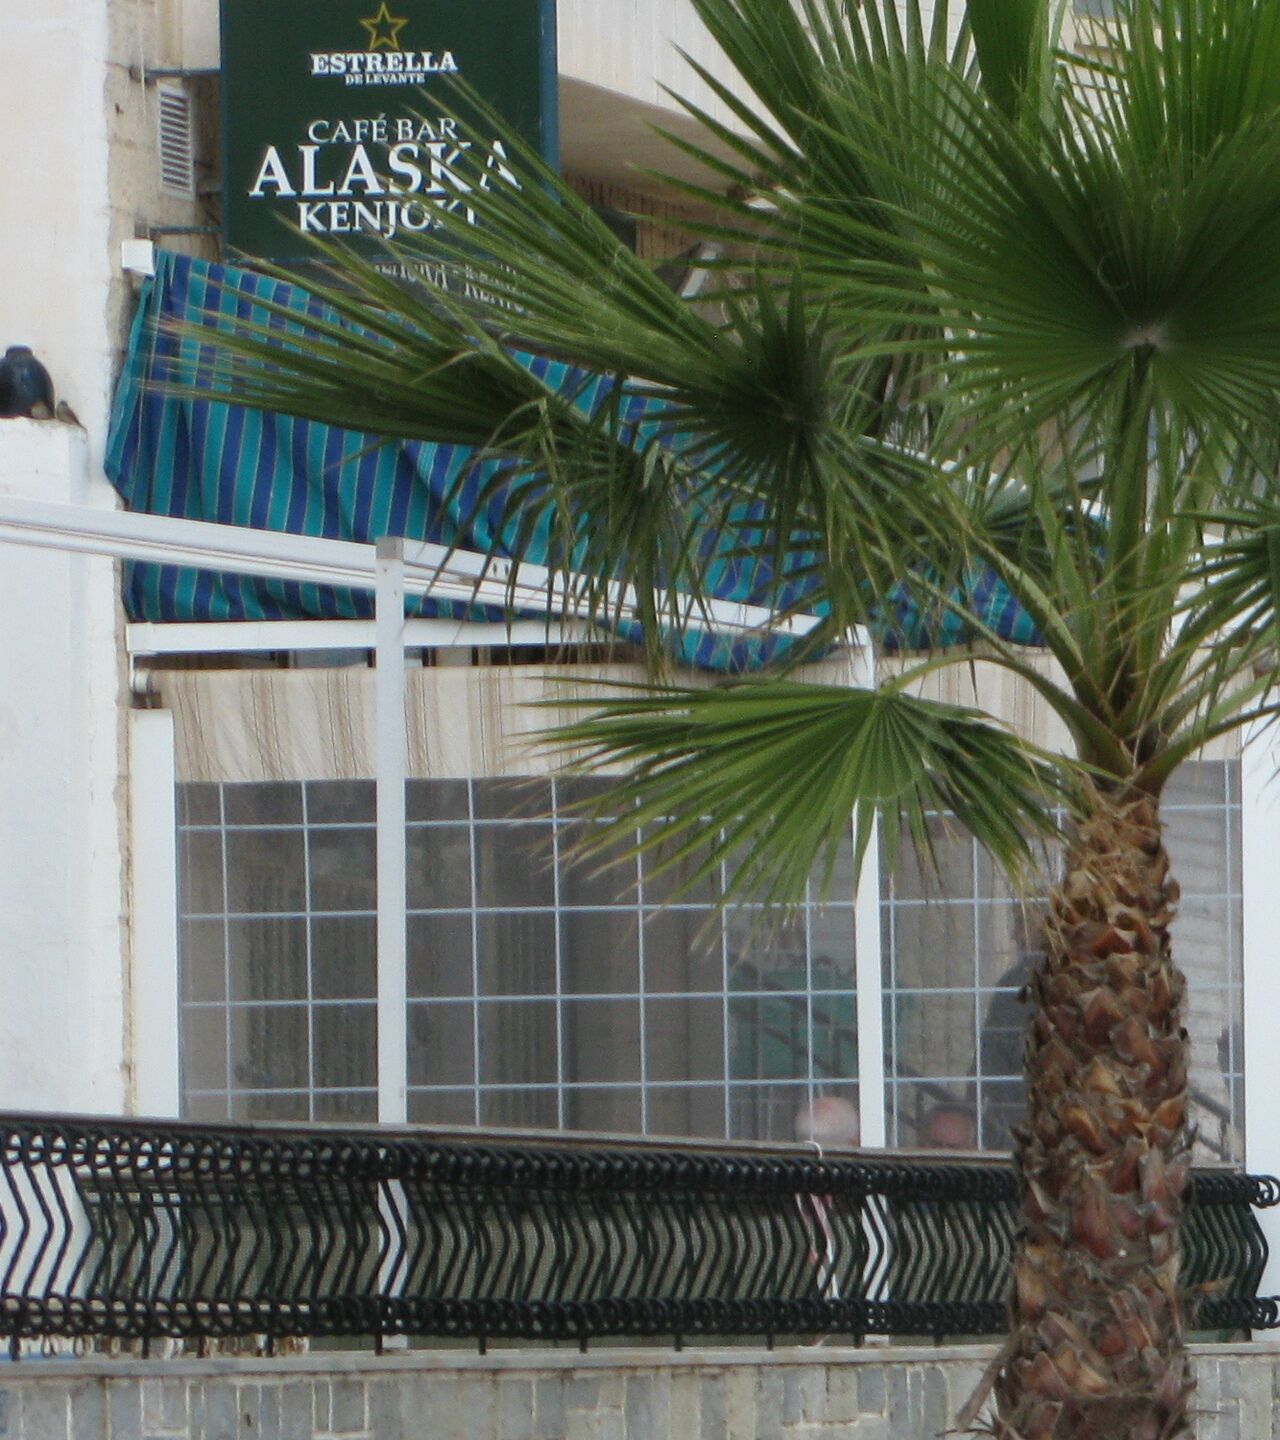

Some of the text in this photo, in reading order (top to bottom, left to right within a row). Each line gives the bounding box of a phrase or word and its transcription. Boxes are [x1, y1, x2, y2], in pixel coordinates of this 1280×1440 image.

[310, 51, 458, 74] ESTRELLA
[345, 72, 426, 86] DE LEVANTE
[308, 113, 458, 144] CAFÉ BAR
[248, 140, 523, 198] ALASKA
